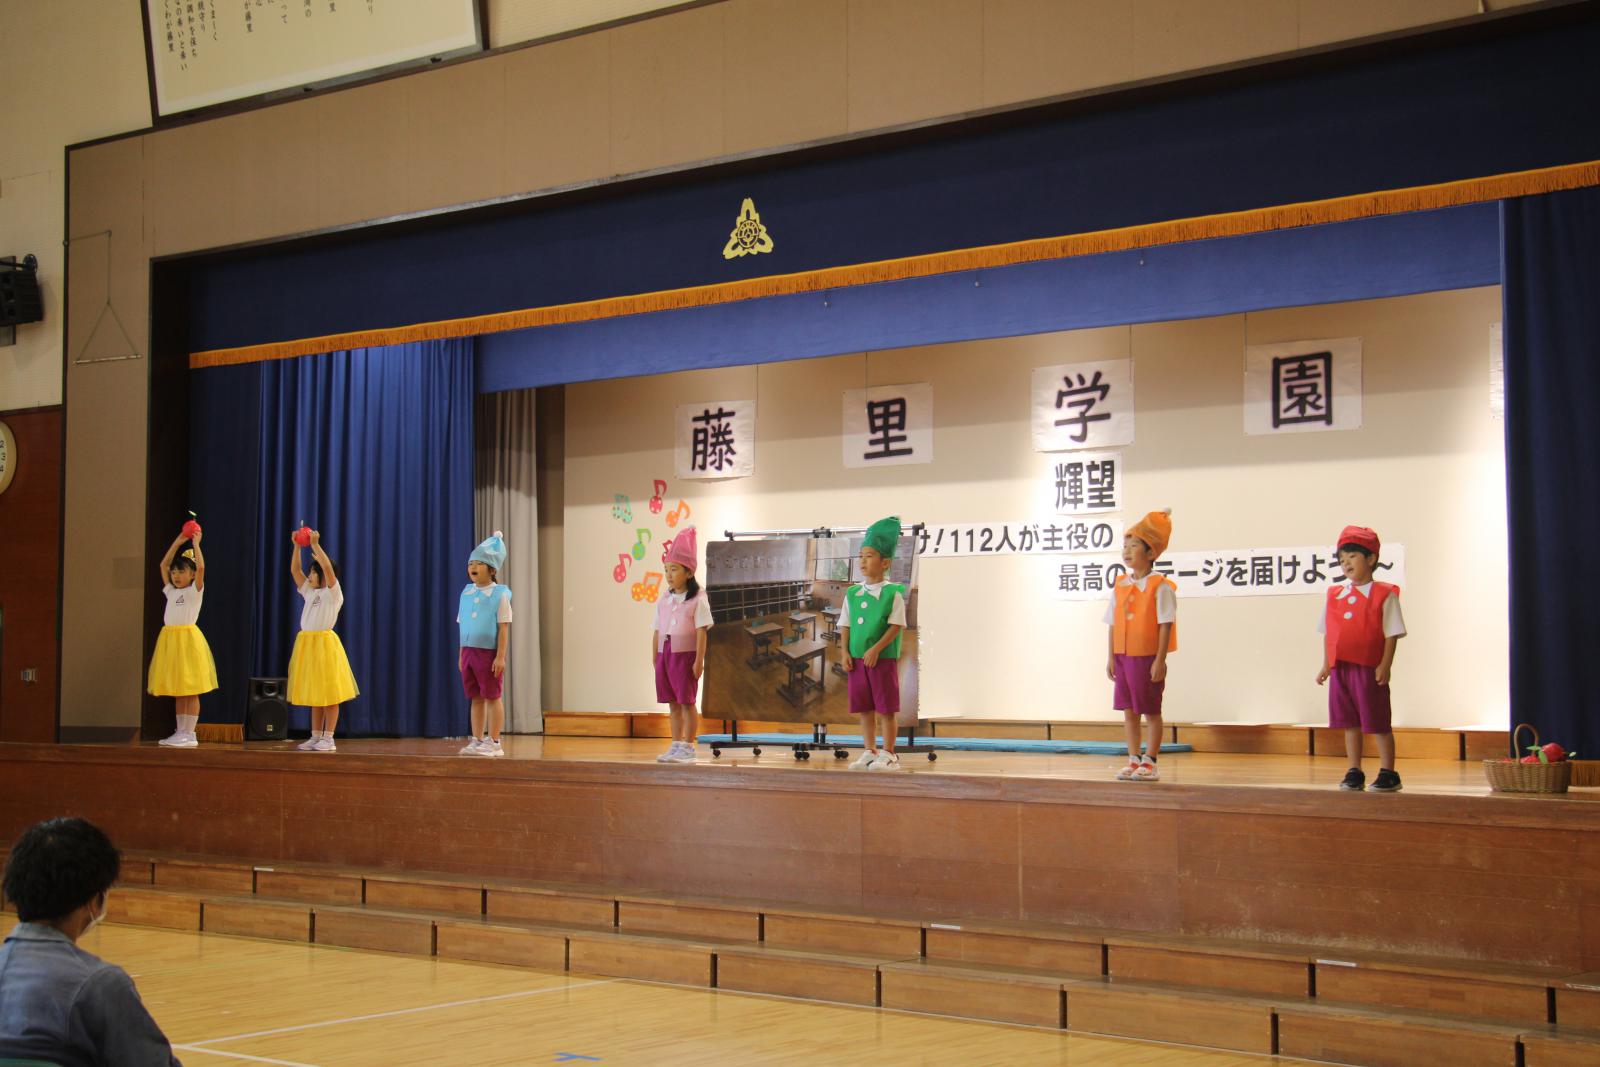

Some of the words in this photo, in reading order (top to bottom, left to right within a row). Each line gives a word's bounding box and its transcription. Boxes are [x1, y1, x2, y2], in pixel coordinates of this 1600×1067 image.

[692, 407, 737, 471] 藤
[863, 397, 914, 459] 里
[1054, 371, 1112, 443] 学
[1271, 351, 1333, 429] 園
[1055, 460, 1116, 510] 輝望
